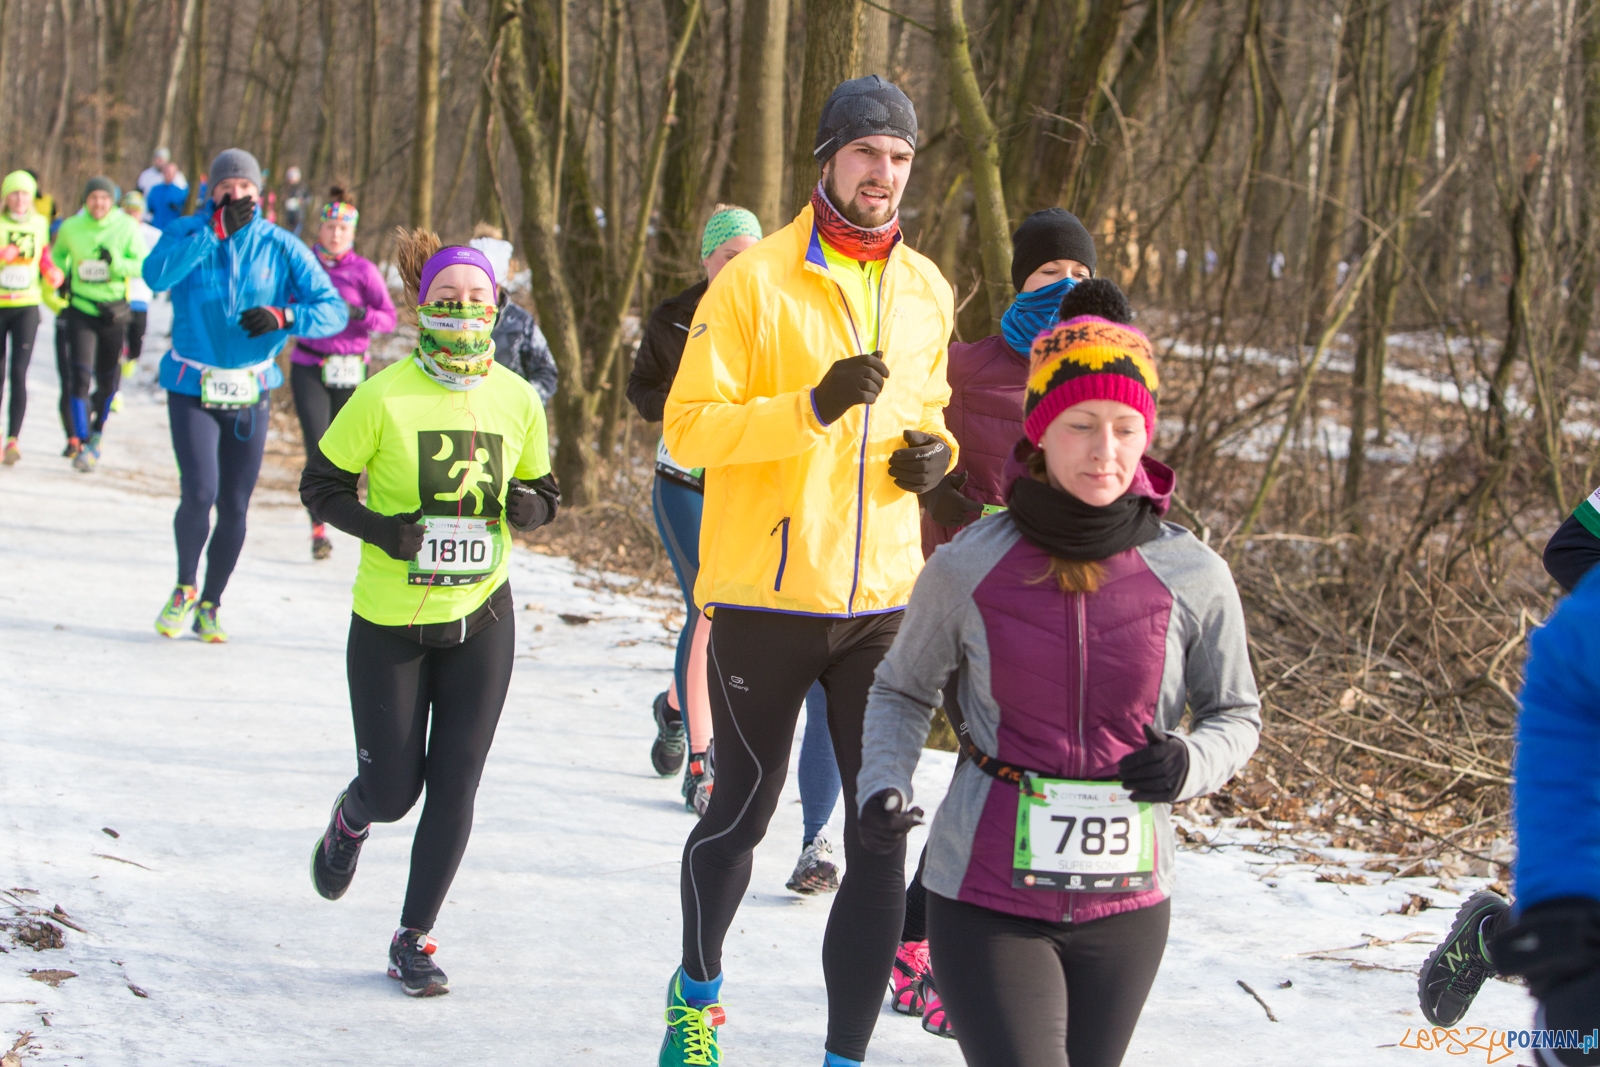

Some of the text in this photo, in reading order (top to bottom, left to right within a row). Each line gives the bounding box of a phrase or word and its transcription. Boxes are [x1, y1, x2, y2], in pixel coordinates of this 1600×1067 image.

[212, 381, 249, 396] 1925
[427, 538, 486, 563] 1810
[1050, 815, 1130, 856] 783
[1058, 860, 1122, 871] SUPER SONIC
